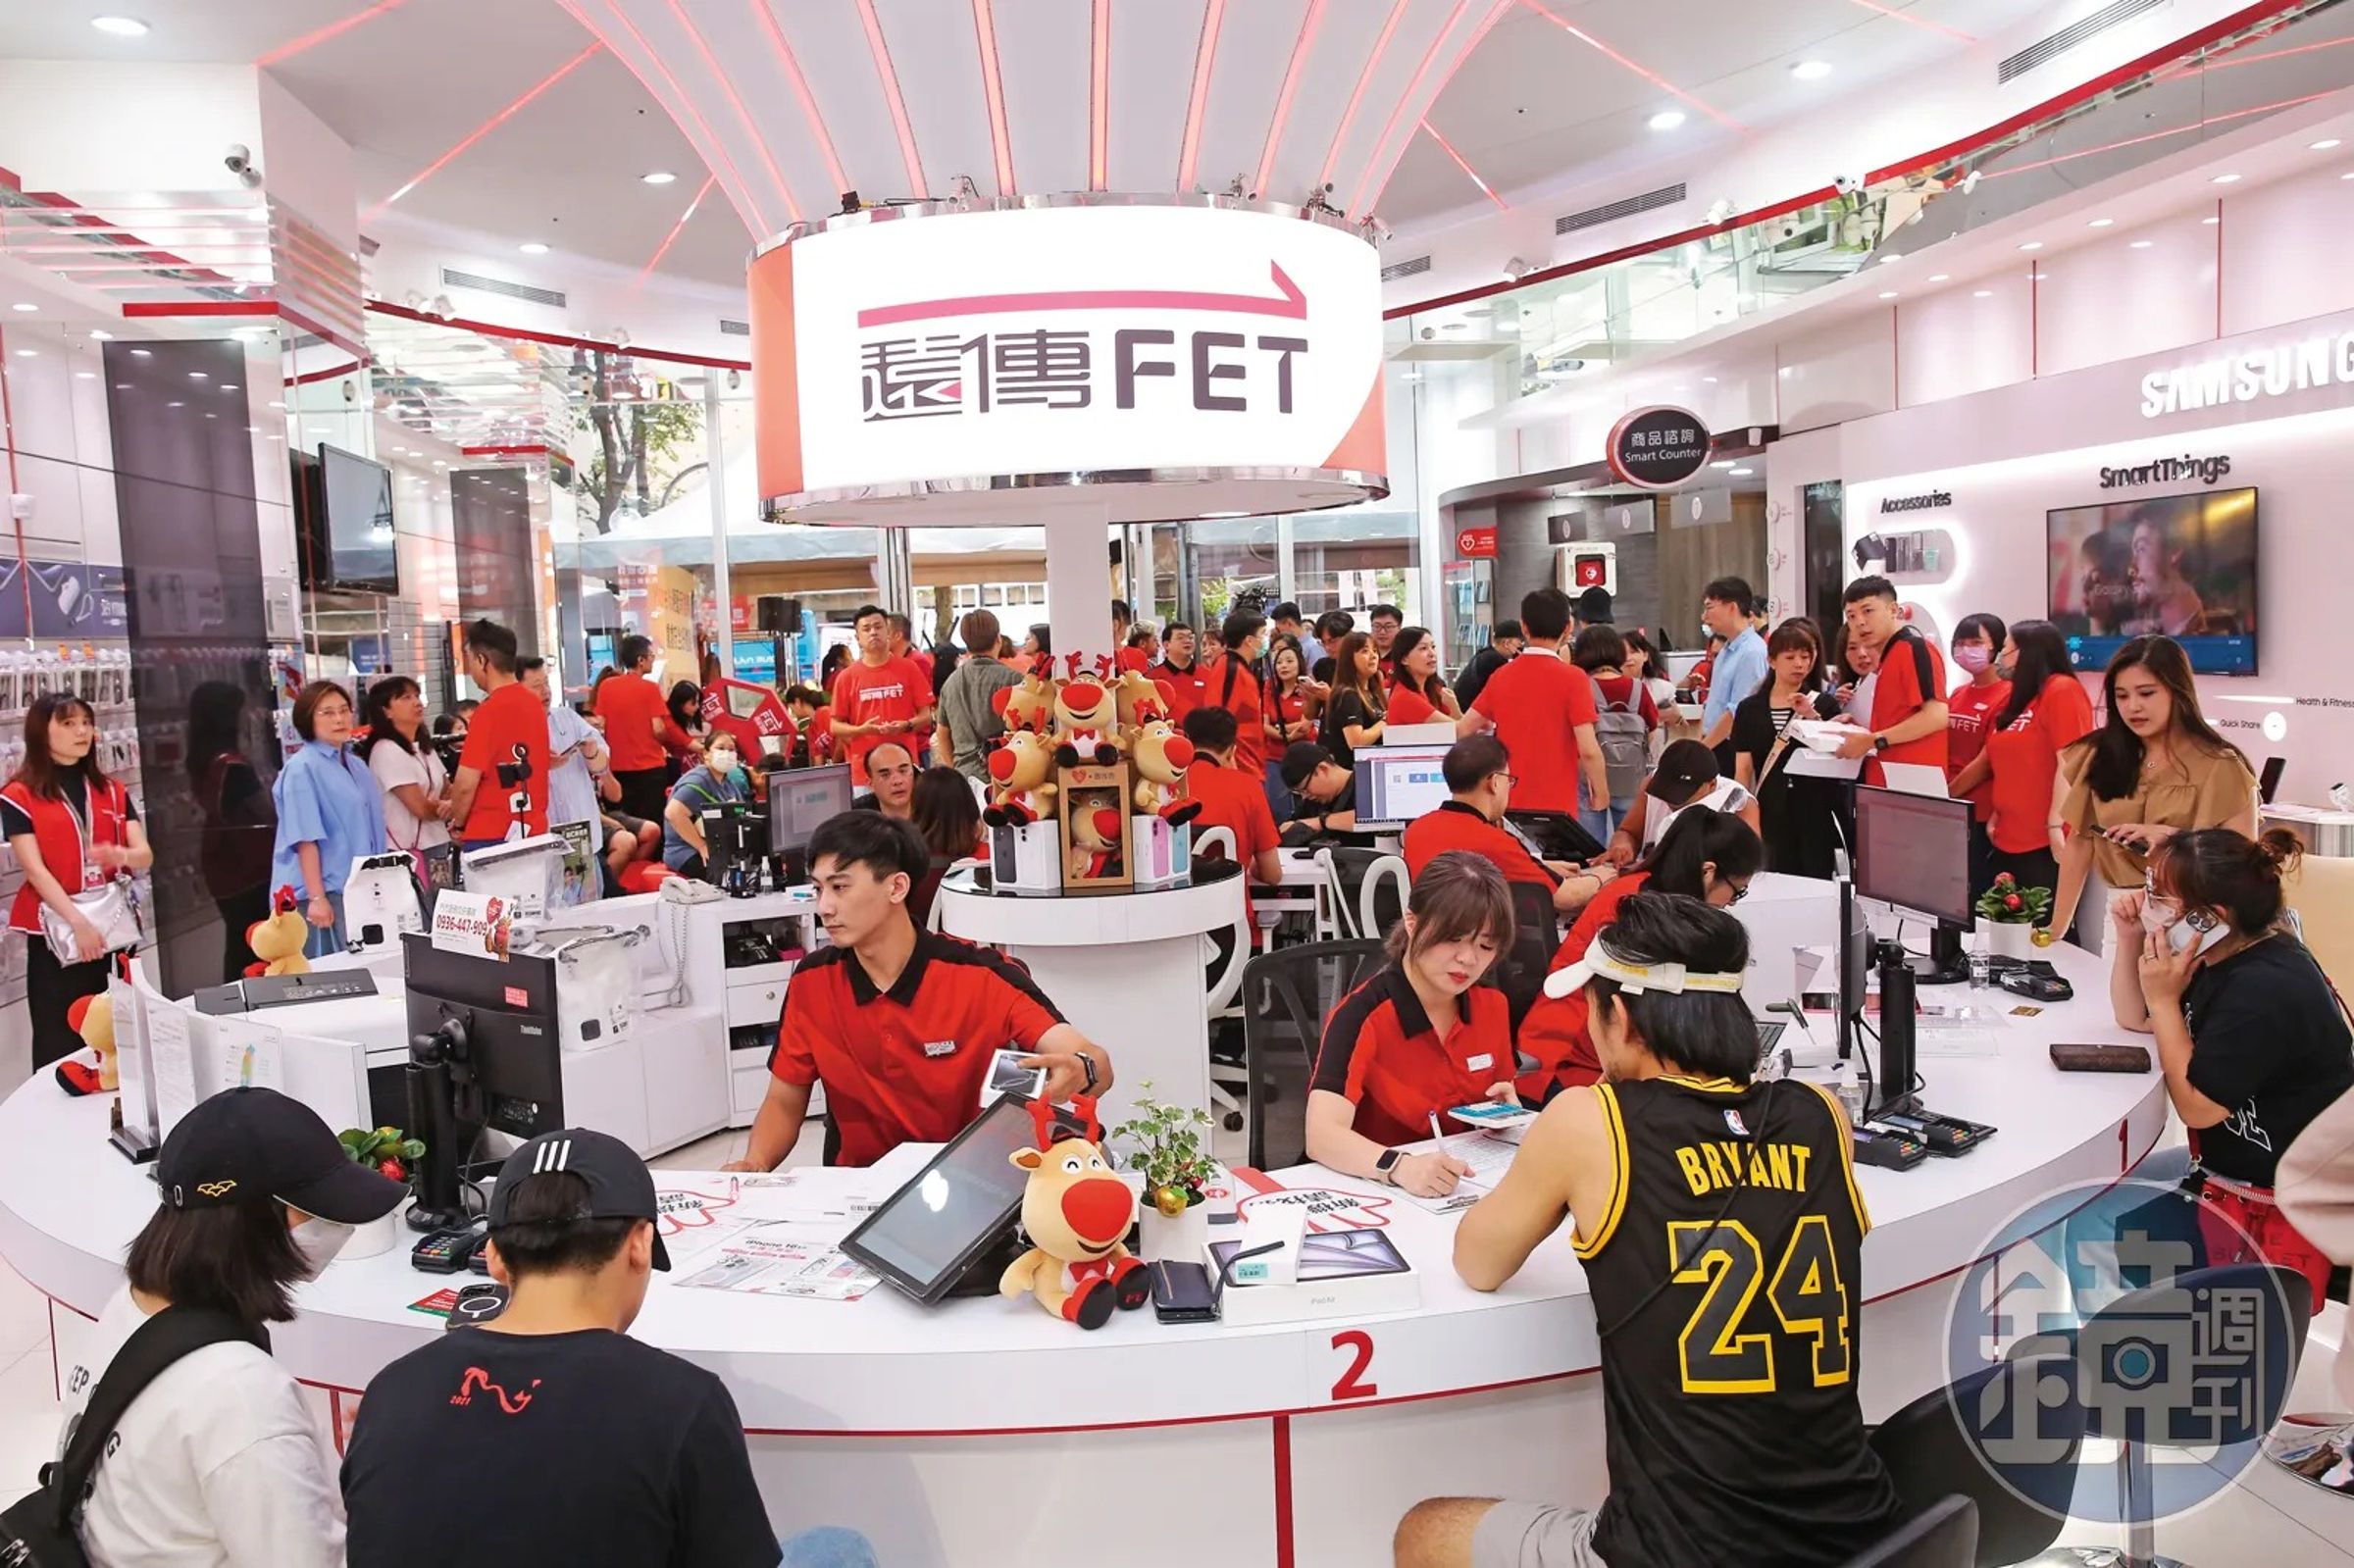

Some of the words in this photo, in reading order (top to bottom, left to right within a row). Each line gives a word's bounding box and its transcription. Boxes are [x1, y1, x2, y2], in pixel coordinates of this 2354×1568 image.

[859, 328, 1091, 422] 遠傳
[1114, 329, 1308, 415] FET
[2141, 331, 2354, 419] SAMSUNG
[1625, 451, 1657, 463] Smart
[1659, 448, 1702, 460] Counter
[1631, 429, 1694, 447] 商品諮詢
[2100, 453, 2230, 488] SmartThings
[1880, 489, 1952, 514] Accessories
[2220, 718, 2239, 728] Quick
[2240, 720, 2261, 730] Share
[2296, 697, 2321, 706] Health
[2322, 697, 2328, 706] &
[2118, 1118, 2128, 1173] 1
[1675, 1140, 1811, 1197] BRYANT
[1666, 1214, 1851, 1394] 24
[1331, 1330, 1377, 1401] 2
